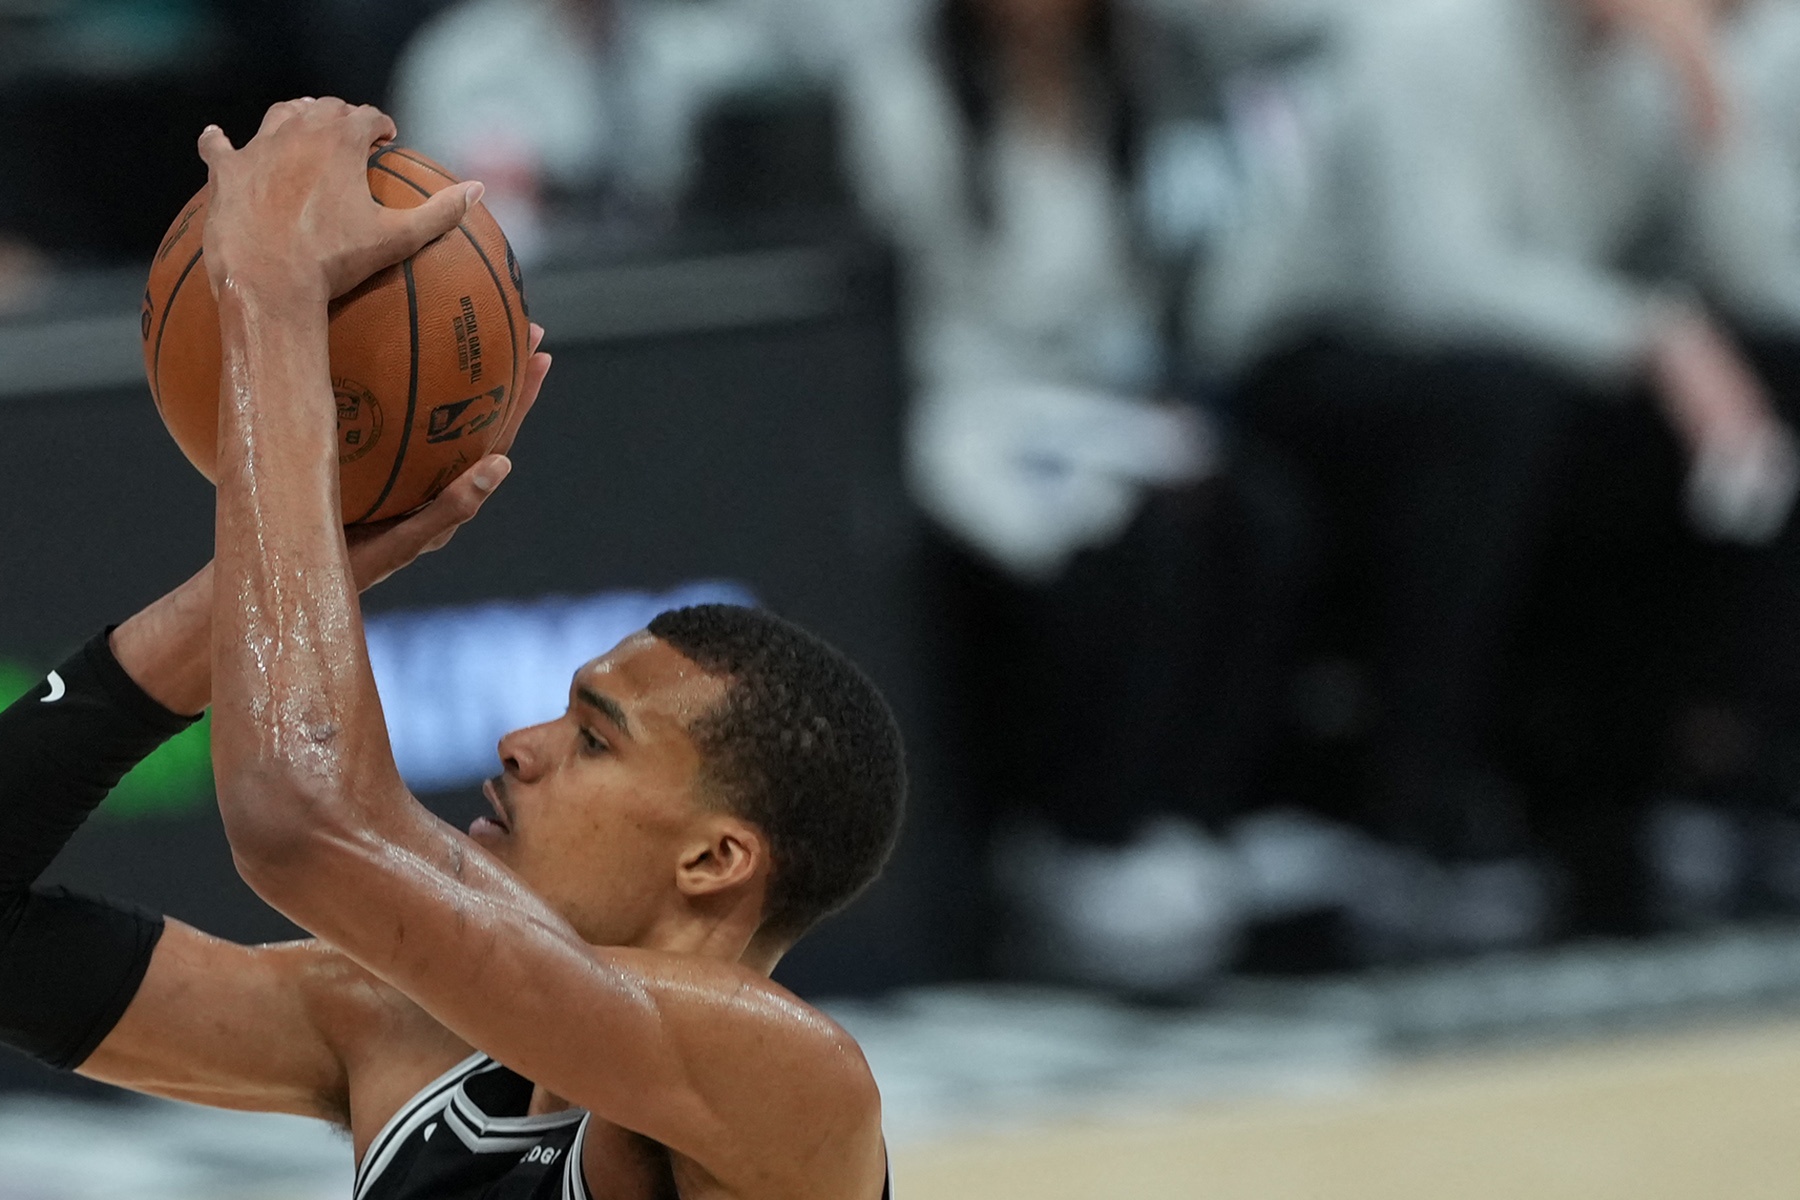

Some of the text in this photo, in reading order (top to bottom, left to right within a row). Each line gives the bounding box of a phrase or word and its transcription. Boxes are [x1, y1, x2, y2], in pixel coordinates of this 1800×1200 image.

[460, 296, 482, 384] OFFICIAL GAME BALL
